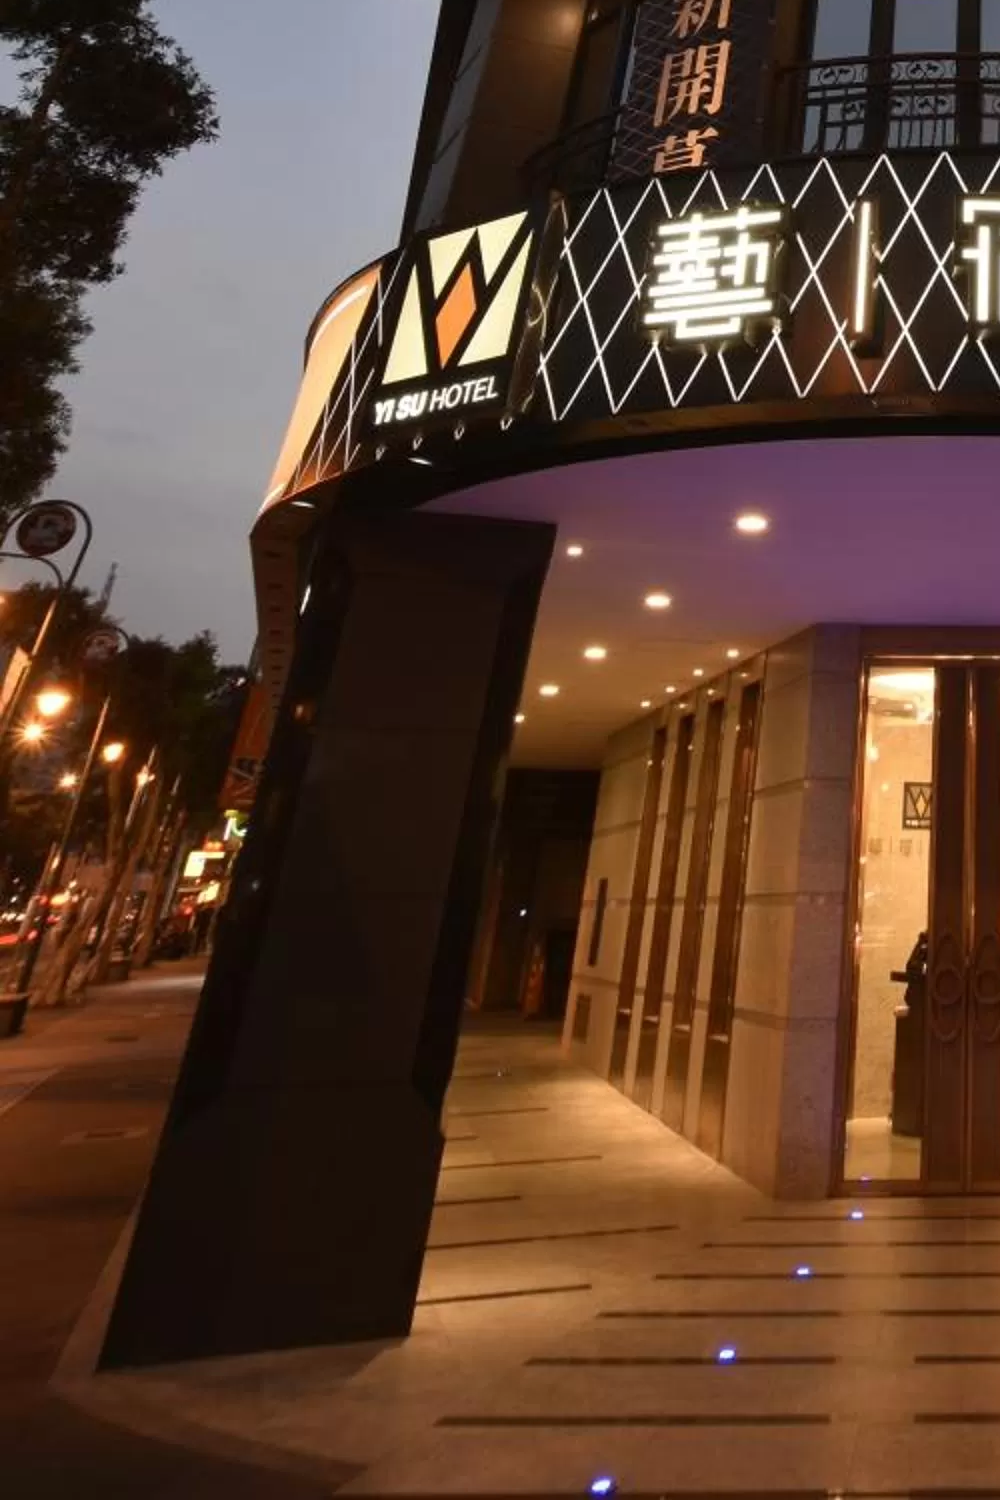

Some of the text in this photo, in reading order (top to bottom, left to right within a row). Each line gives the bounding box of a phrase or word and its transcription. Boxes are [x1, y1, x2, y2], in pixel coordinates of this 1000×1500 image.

[374, 375, 499, 426] YI SU HOTEL
